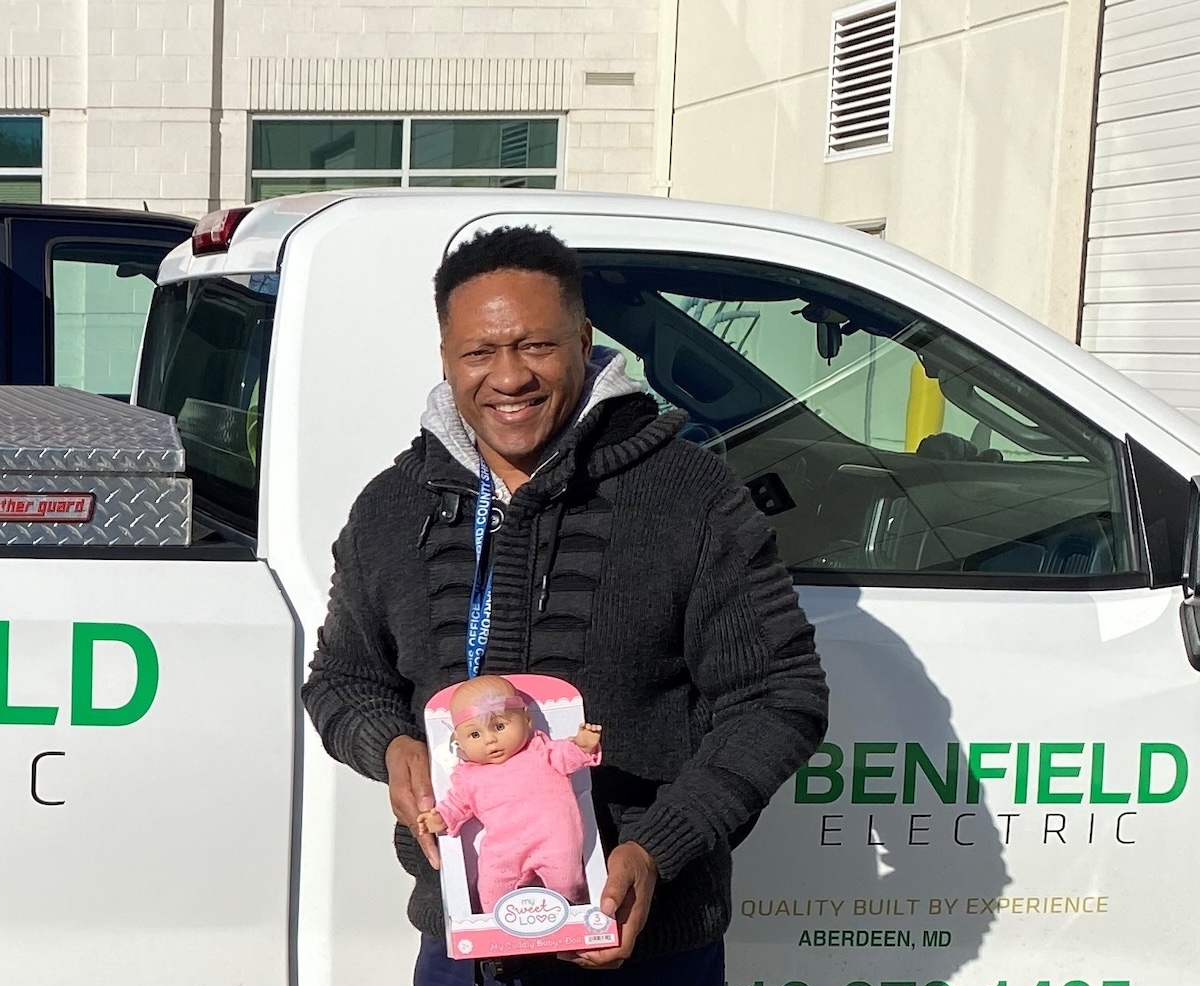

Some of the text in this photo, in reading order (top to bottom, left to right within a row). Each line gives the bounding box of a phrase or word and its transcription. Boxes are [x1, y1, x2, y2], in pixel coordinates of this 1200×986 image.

[37, 498, 86, 516] guard
[476, 481, 492, 525] COUNTY
[793, 742, 1189, 805] BENFIELD
[820, 811, 1137, 847] ELECTRIC
[505, 899, 561, 923] Sweet
[521, 898, 535, 907] my
[740, 895, 1109, 917] QUALITY BUILT BY EXPERIENCE
[594, 914, 600, 923] 3
[489, 943, 504, 951] My
[506, 939, 535, 950] Cuddly
[564, 937, 582, 945] Doll
[798, 930, 951, 950] ABERDEEN, MD
